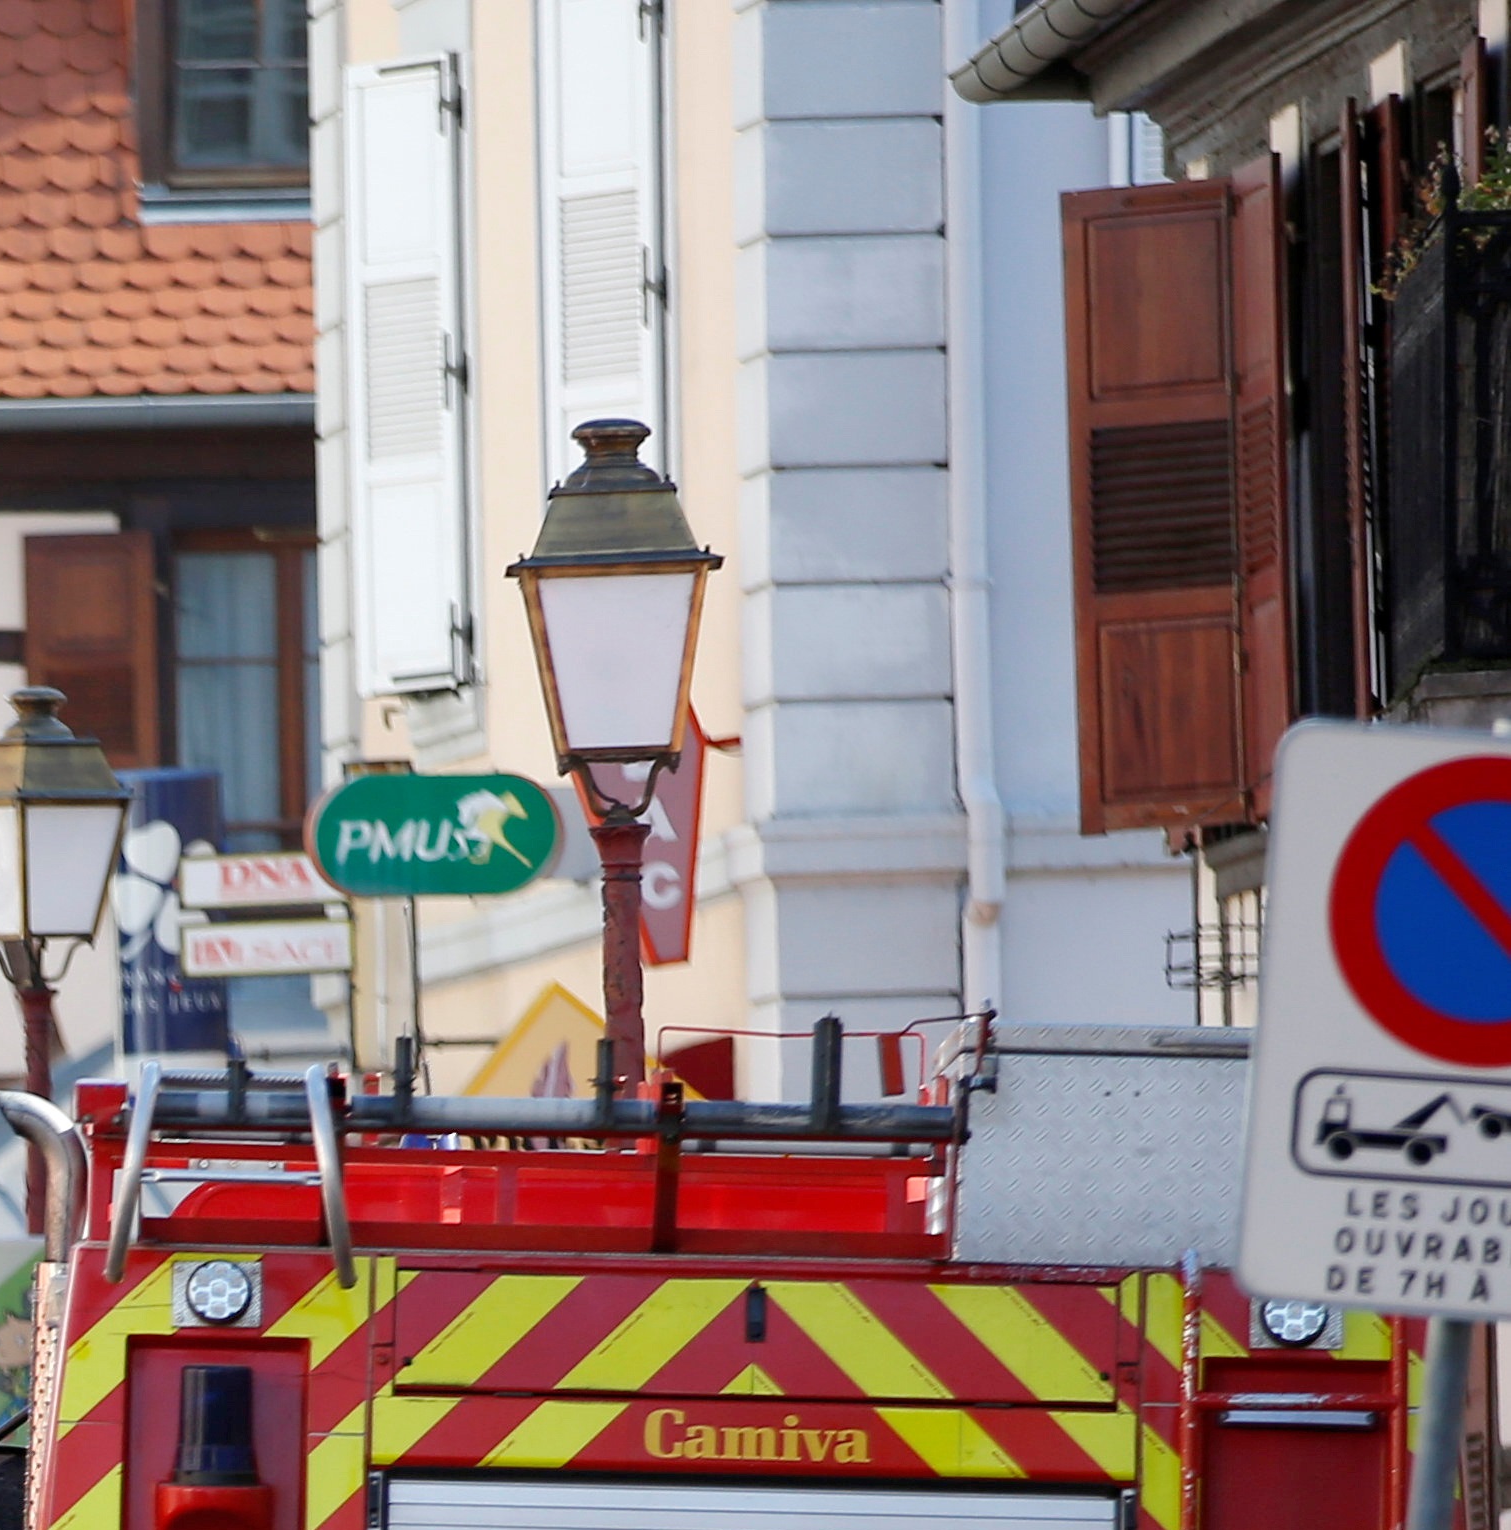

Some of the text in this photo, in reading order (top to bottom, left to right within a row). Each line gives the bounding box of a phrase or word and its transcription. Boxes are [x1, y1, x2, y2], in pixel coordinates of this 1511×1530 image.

[336, 818, 452, 865] PMU
[1346, 1189, 1420, 1219] LES
[1335, 1227, 1511, 1264] OUVRAB
[1327, 1264, 1374, 1294] DE
[1400, 1269, 1445, 1298] 7H
[644, 1408, 872, 1463] Camiva
